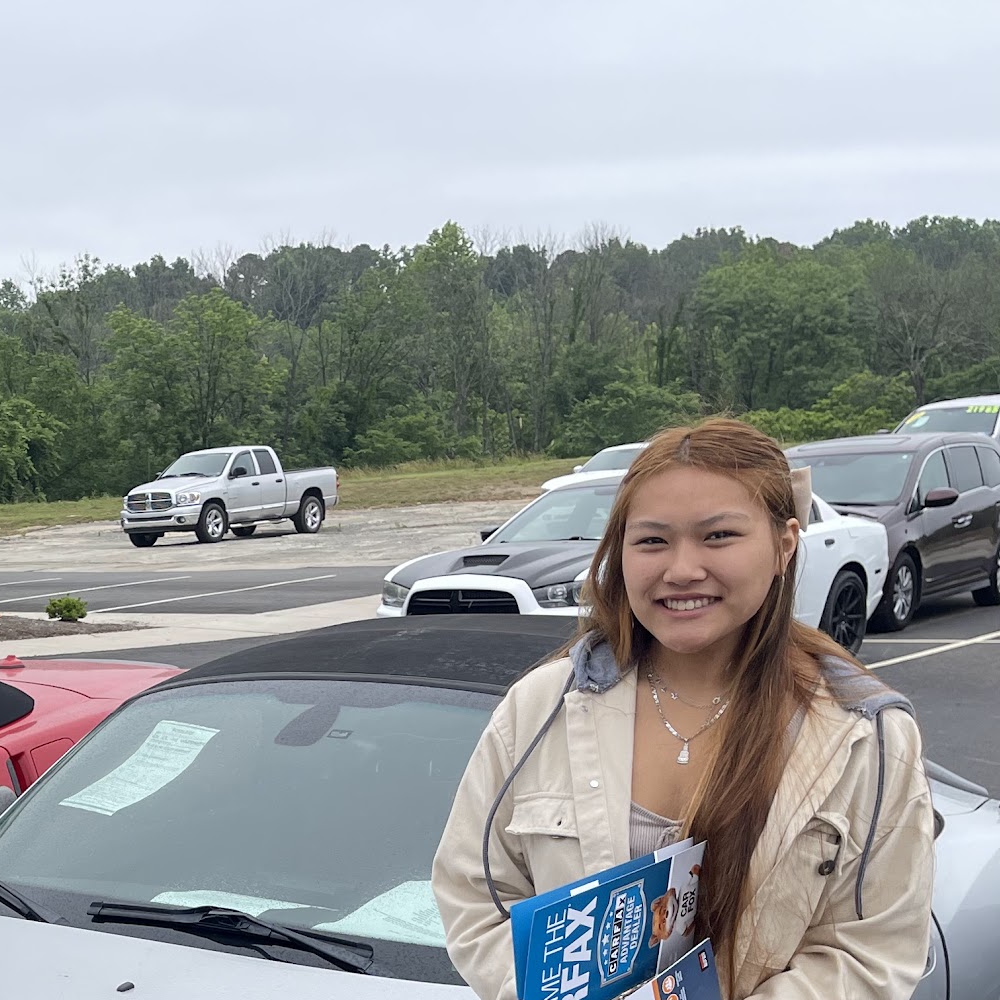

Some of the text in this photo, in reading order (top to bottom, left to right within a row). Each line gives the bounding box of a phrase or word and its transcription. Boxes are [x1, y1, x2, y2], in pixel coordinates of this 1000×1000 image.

[680, 891, 690, 917] CAR
[687, 888, 697, 913] FOX
[543, 908, 567, 963] THE
[607, 892, 627, 976] CARFAX
[620, 895, 636, 964] ADVANTAGE
[629, 903, 642, 950] DEALER
